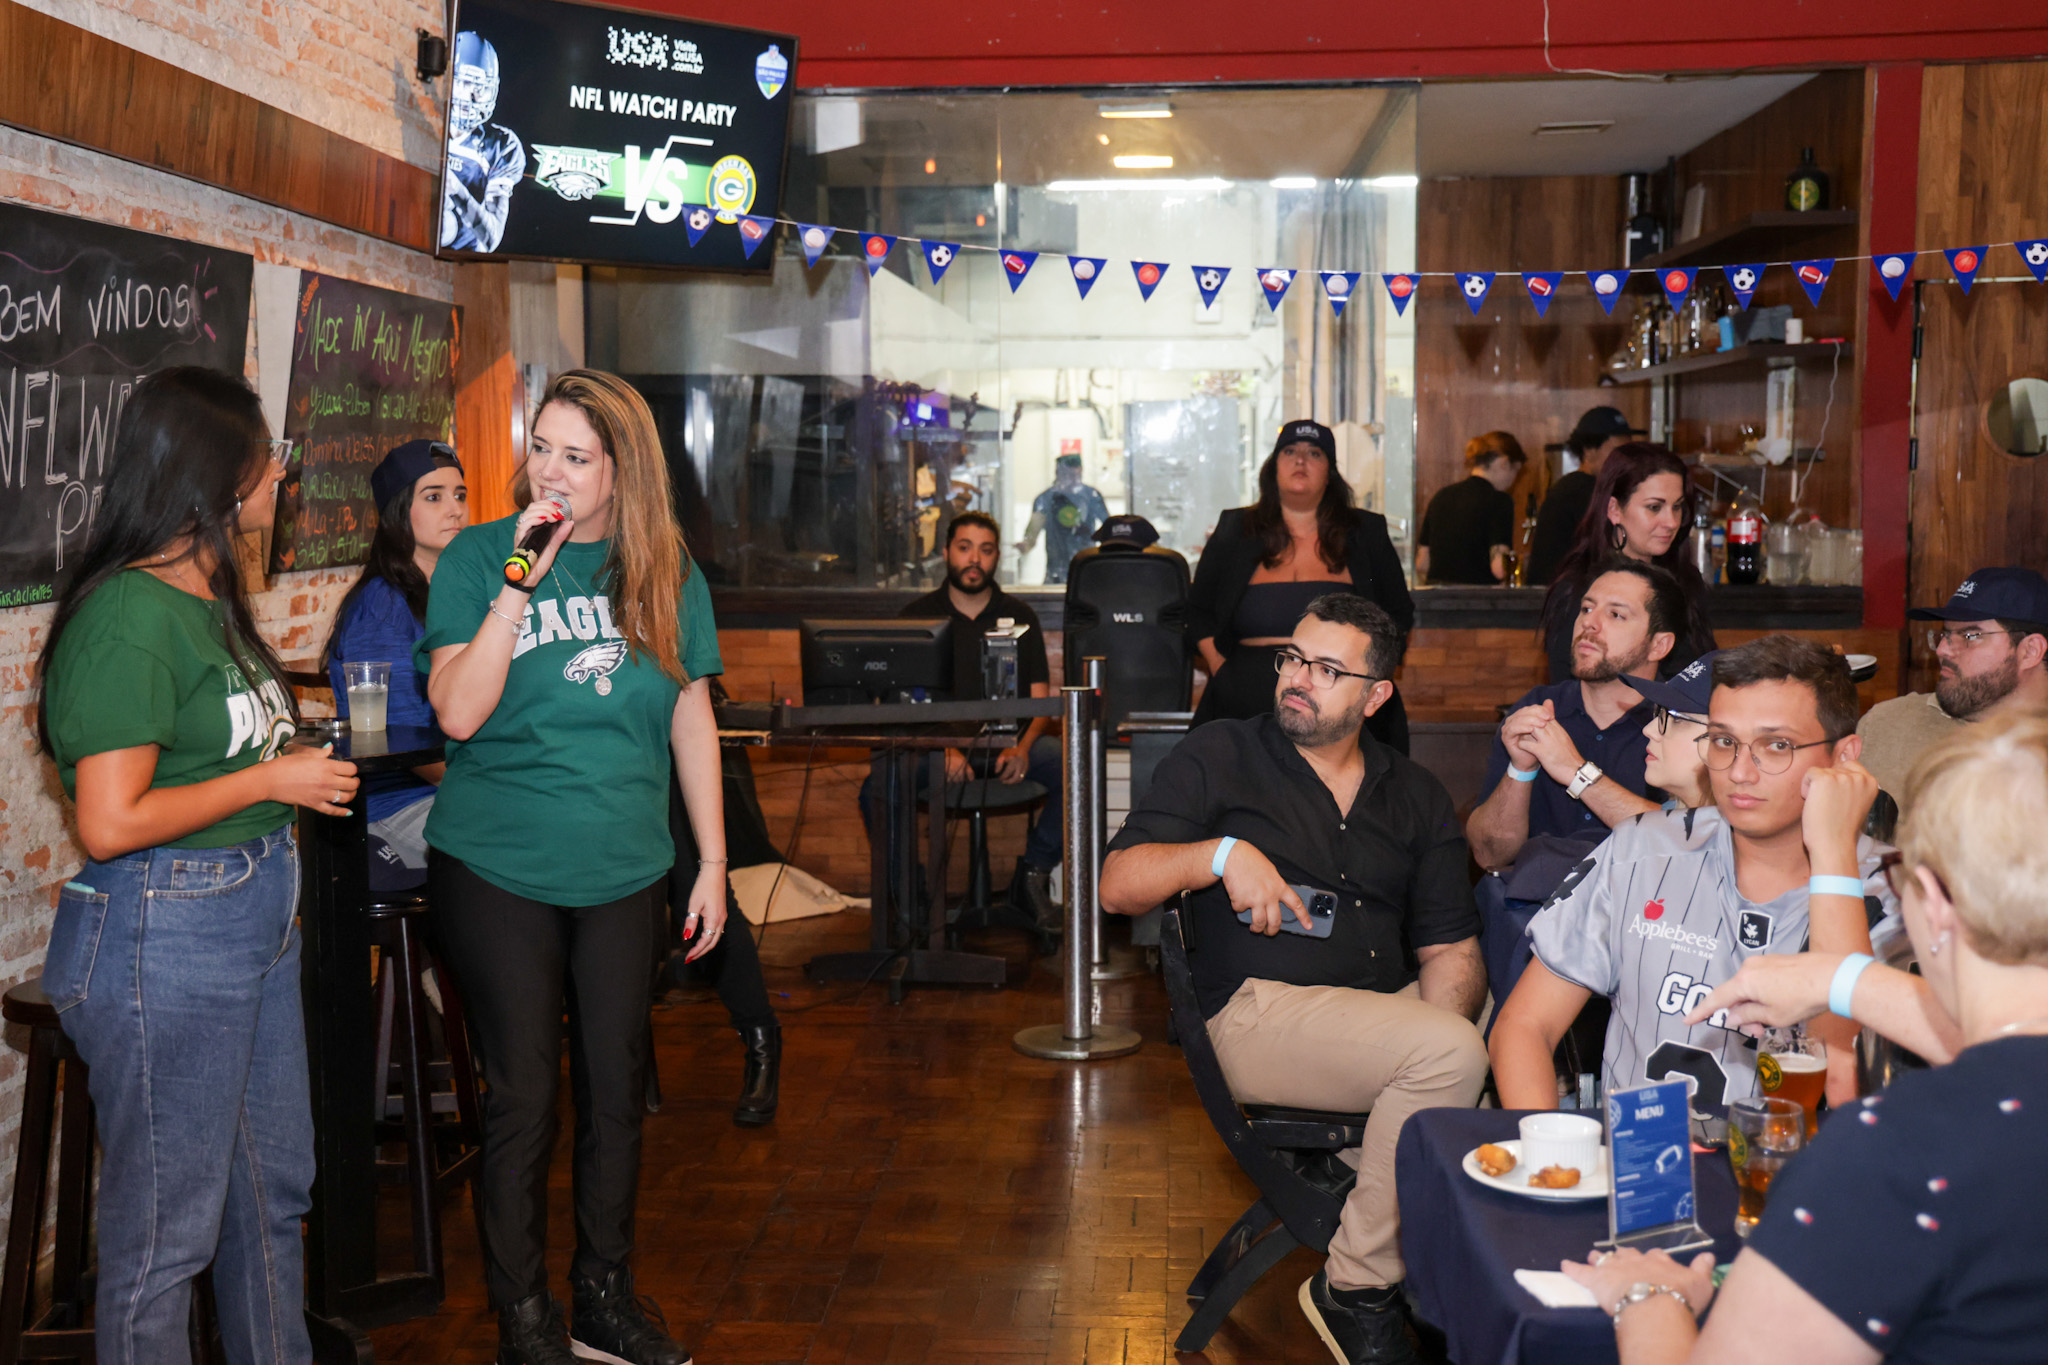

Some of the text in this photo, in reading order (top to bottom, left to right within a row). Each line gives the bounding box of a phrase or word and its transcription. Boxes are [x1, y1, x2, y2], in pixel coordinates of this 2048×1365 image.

[569, 85, 737, 128] NFL WATCH PARTY
[541, 144, 688, 224] EAGLES VS
[1113, 613, 1143, 623] WLS
[864, 661, 887, 671] AOC
[1628, 913, 1720, 951] Applebee's
[1670, 943, 1691, 954] GRILL
[1698, 951, 1714, 960] BAR
[1635, 1104, 1664, 1121] MENU
